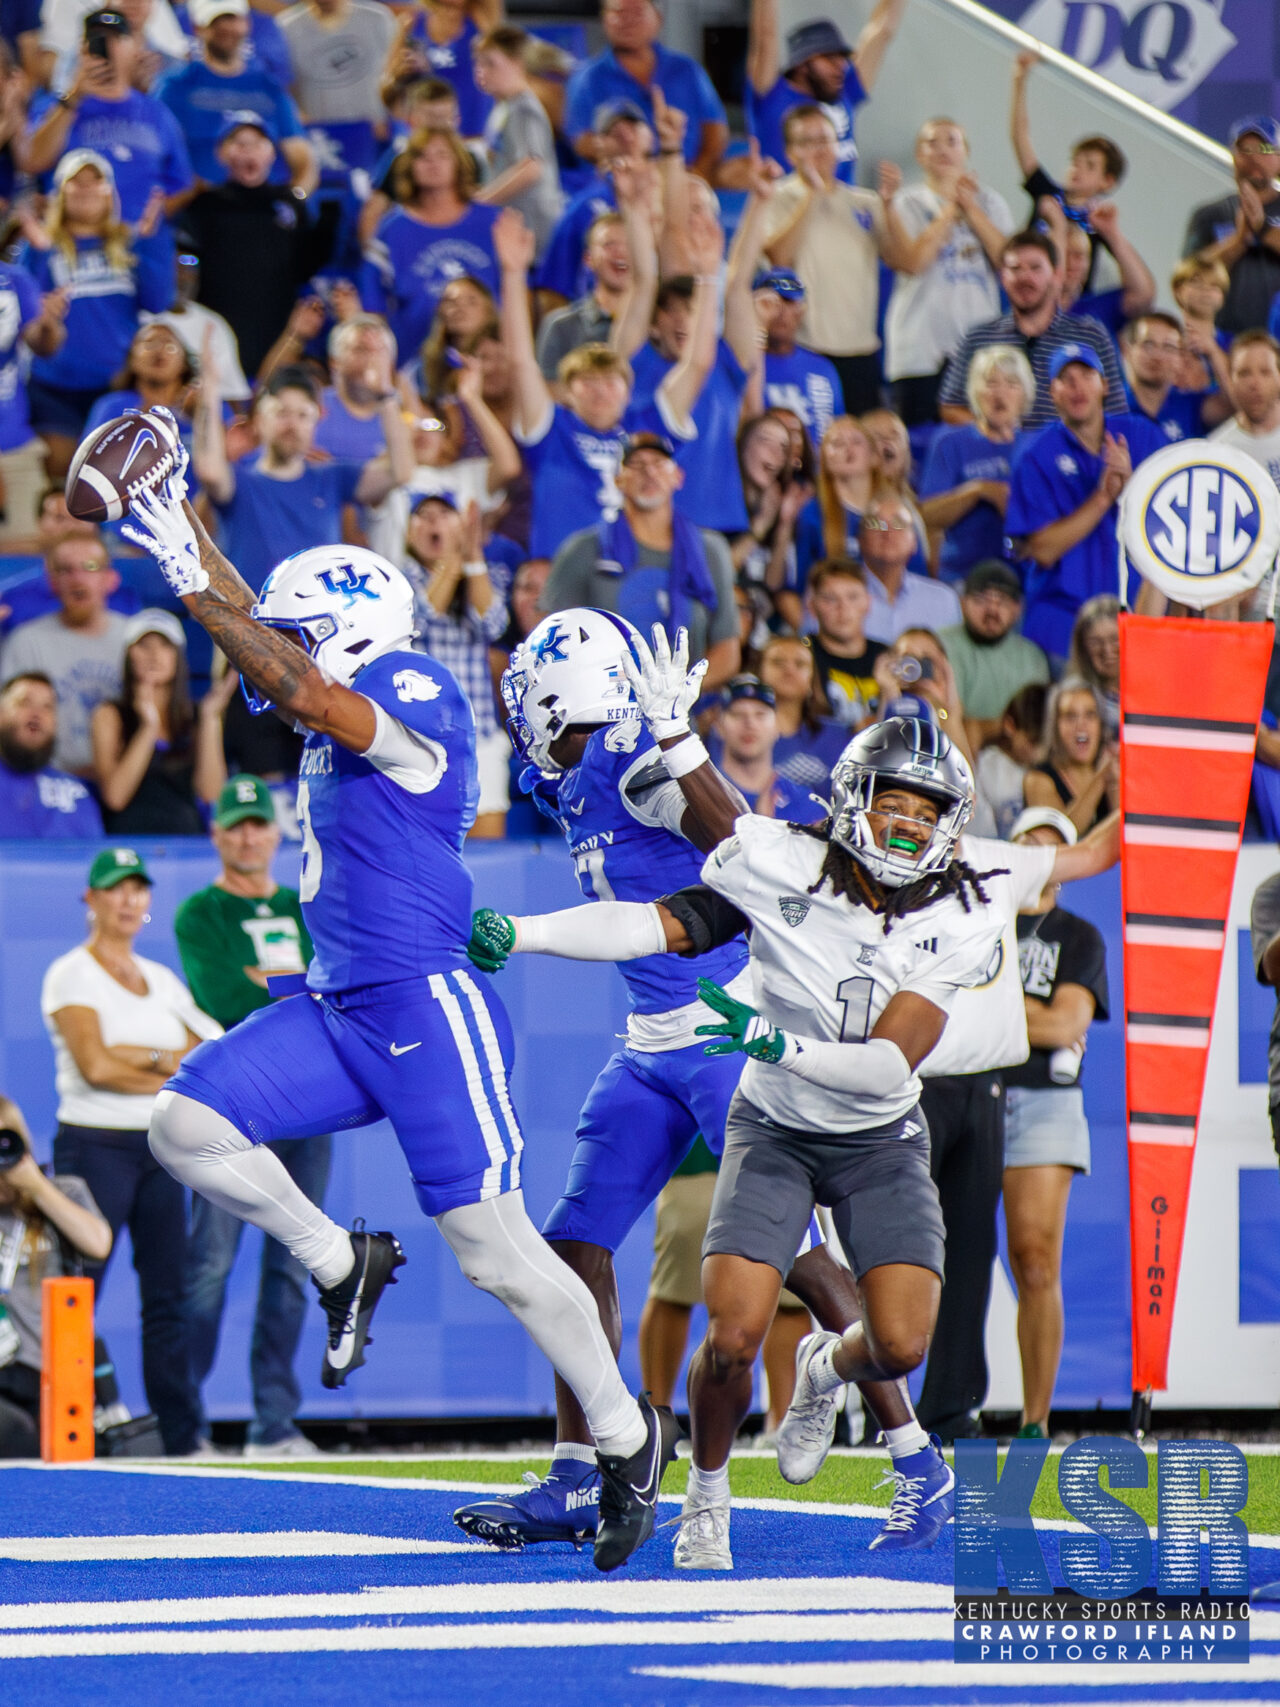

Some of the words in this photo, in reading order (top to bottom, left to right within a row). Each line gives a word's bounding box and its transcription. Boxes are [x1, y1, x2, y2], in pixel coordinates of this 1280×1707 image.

[1059, 2, 1186, 81] DQ
[1151, 467, 1254, 574] SEC
[315, 563, 381, 610] UK
[607, 706, 642, 720] KENTU
[857, 945, 876, 966] E
[836, 975, 874, 1043] 1
[1148, 1196, 1168, 1315] Gilman
[566, 1486, 599, 1512] NIKE
